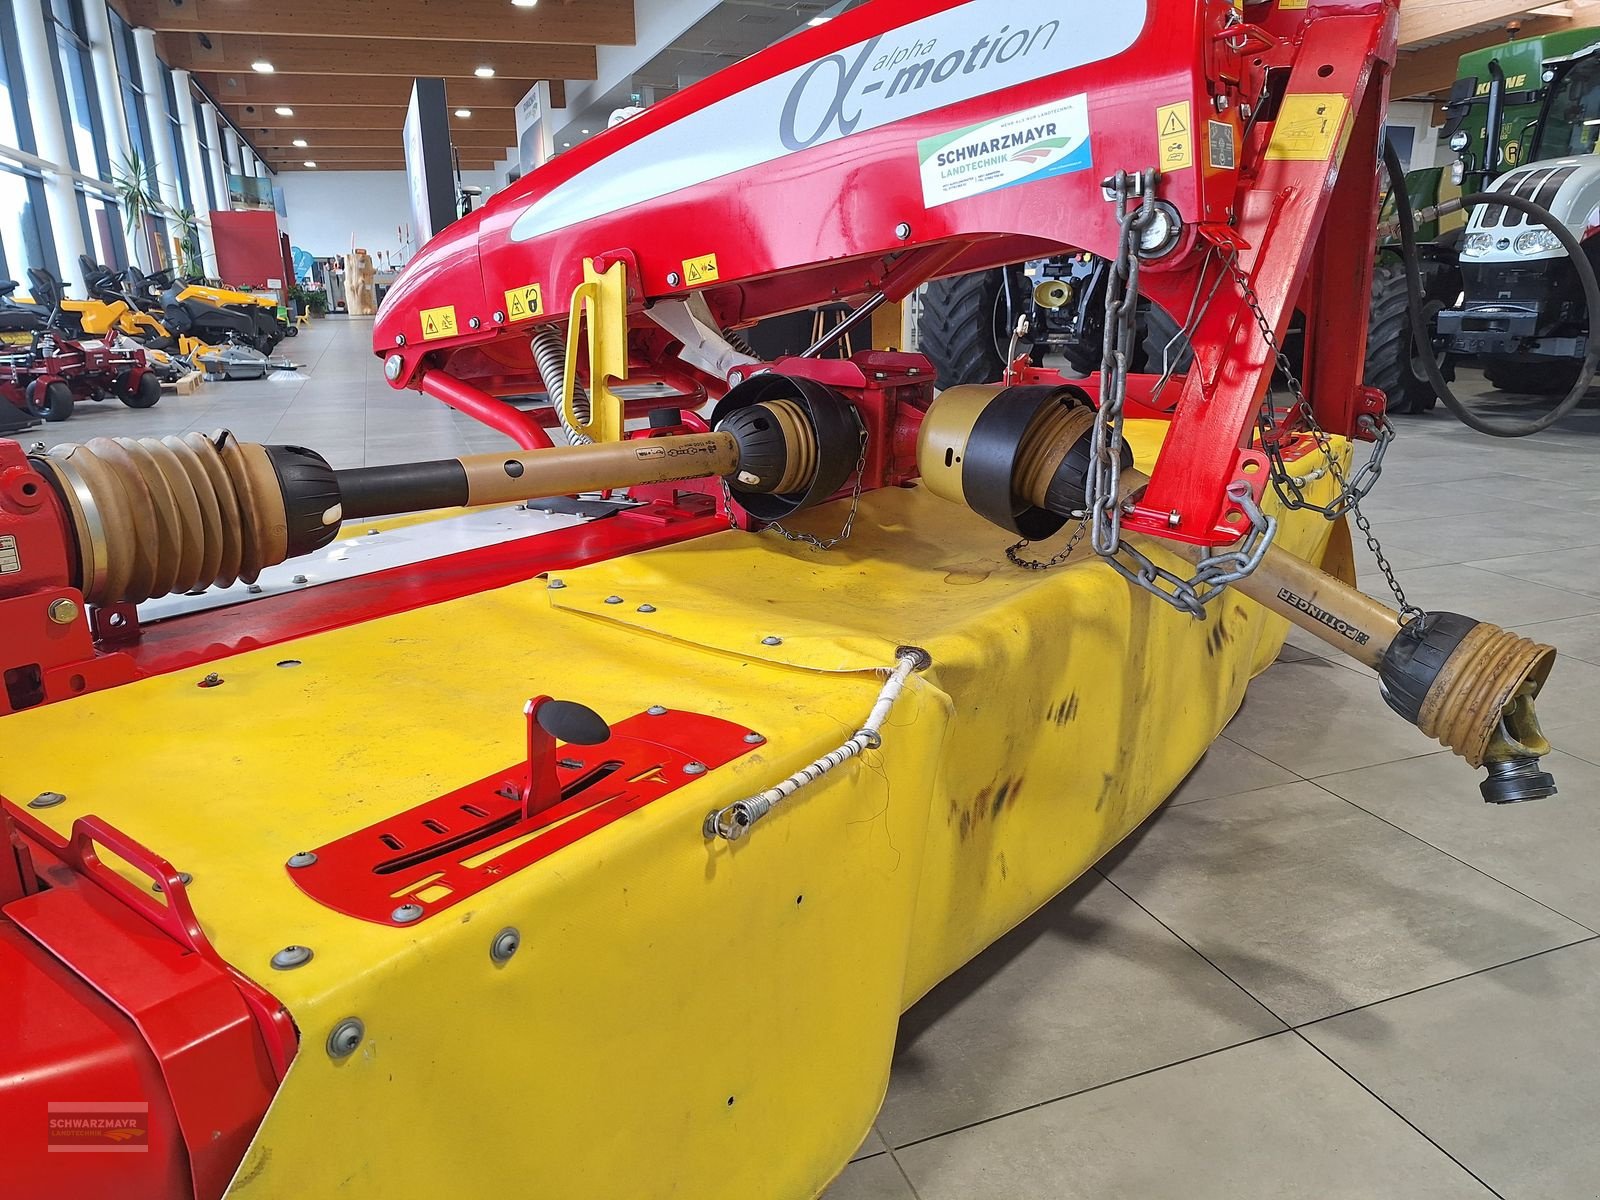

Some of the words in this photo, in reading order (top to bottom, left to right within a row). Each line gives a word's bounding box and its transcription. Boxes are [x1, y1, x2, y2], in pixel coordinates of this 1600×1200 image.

[872, 38, 937, 72] alpha
[1476, 74, 1526, 96] KNE
[937, 122, 1057, 167] SCHWARZMAYR
[941, 153, 1008, 179] LANDTECHNIK
